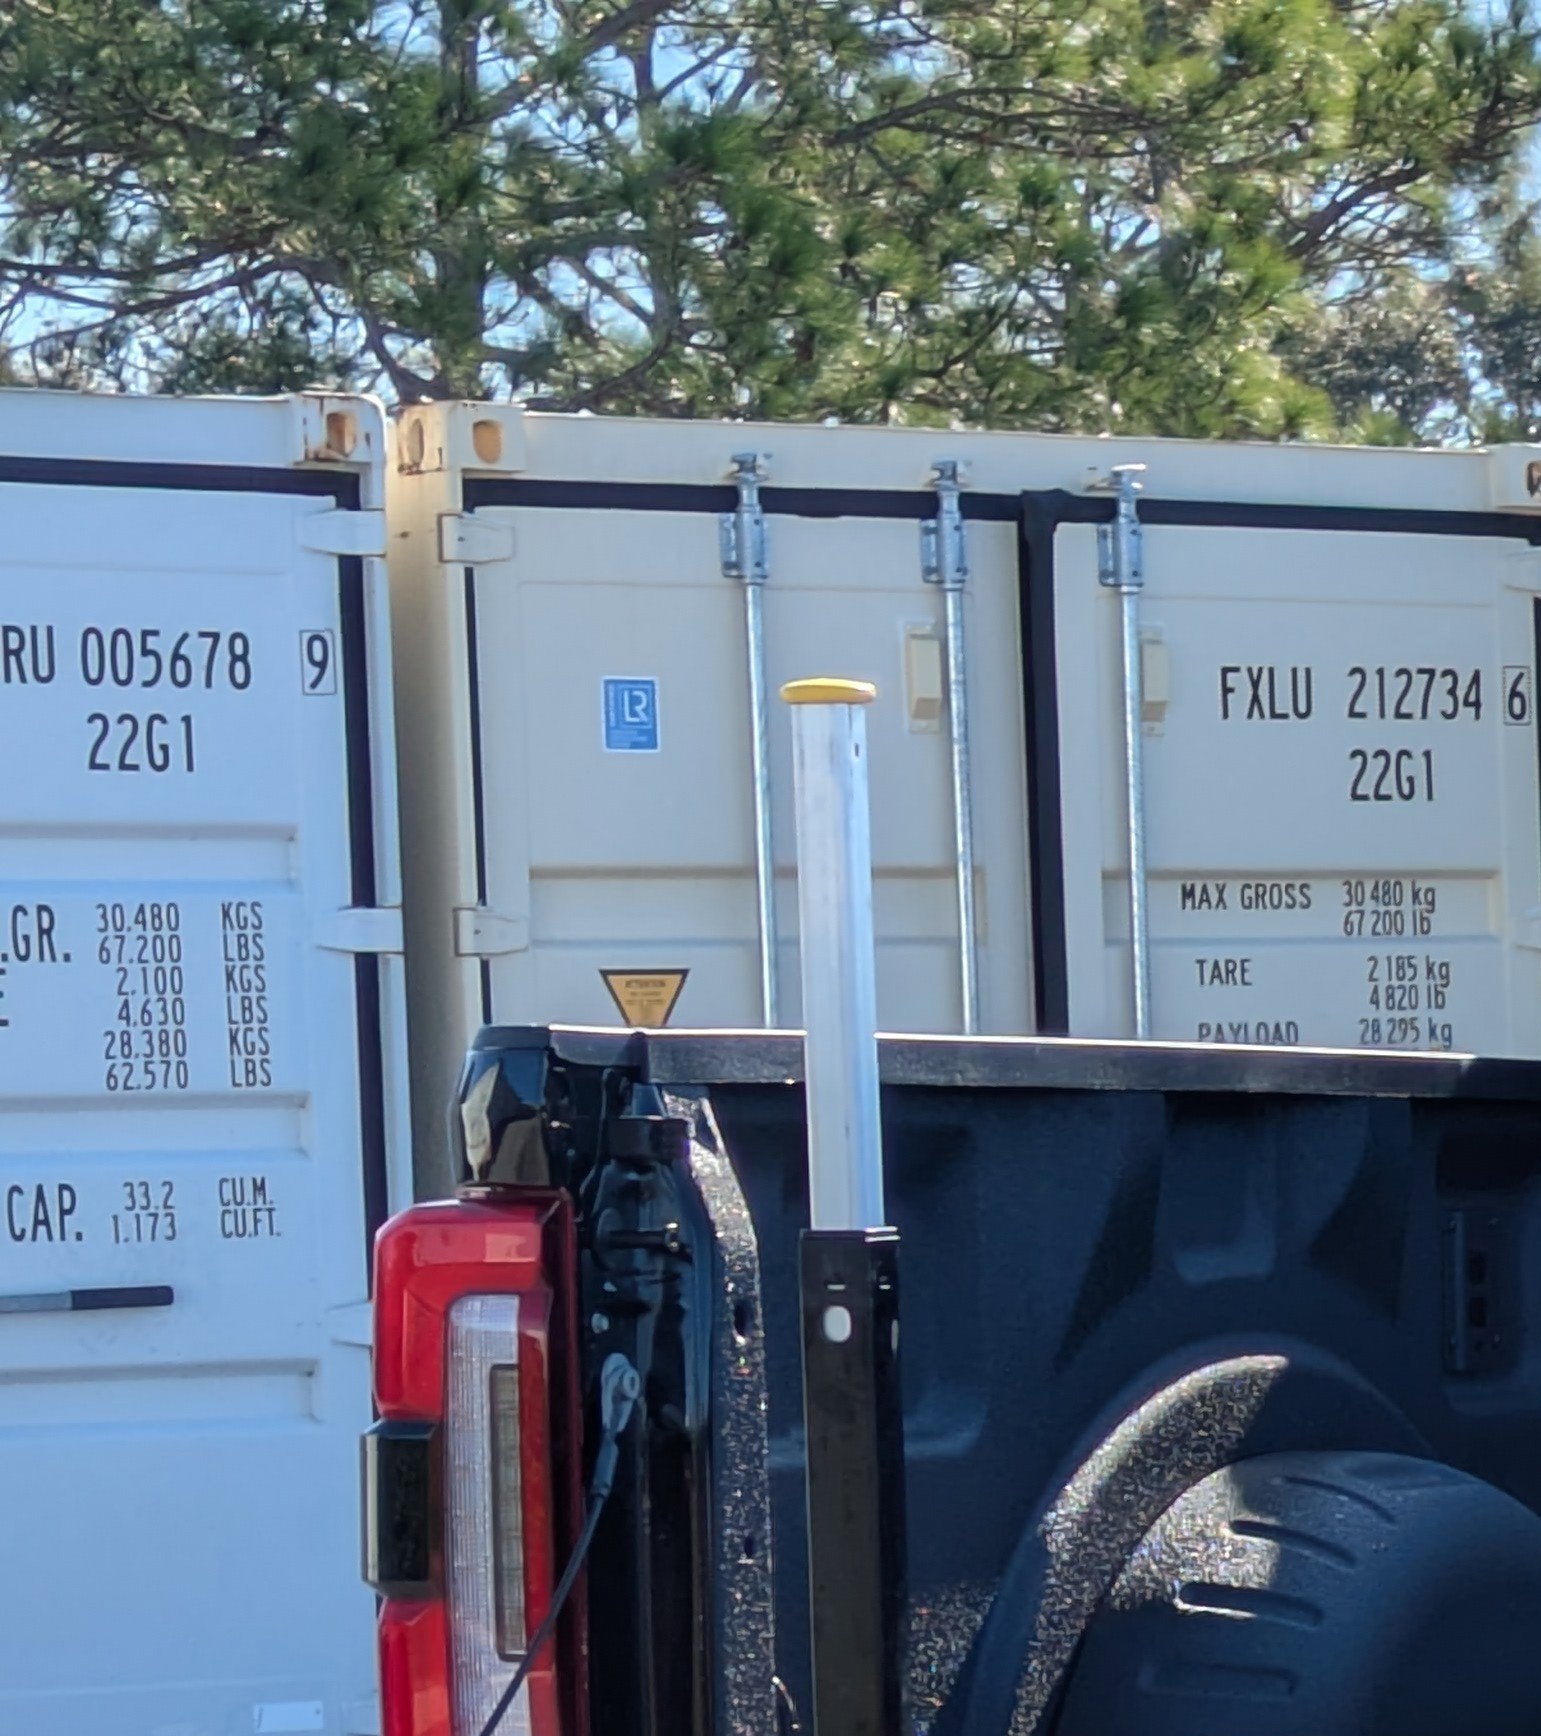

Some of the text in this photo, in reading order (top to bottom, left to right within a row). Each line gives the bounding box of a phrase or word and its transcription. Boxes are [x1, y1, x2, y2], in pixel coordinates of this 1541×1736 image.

[1, 624, 330, 691] RU 005678 9
[1219, 665, 1528, 721] FXLU 212734 6
[86, 712, 195, 773] 22G1
[1349, 748, 1434, 802] 22G1
[1180, 882, 1228, 910] MAX
[1240, 882, 1312, 910] GROSS
[1411, 879, 1437, 914] kg
[96, 902, 181, 933] 30.480
[221, 900, 264, 932] KGS
[1411, 908, 1432, 936] lb
[97, 932, 265, 965] 67.200 LBS
[116, 963, 267, 996] 2.100 KGS
[1195, 958, 1253, 987] TARE
[1424, 954, 1451, 987] kg
[117, 995, 269, 1028] 4.630 LBS
[1427, 983, 1446, 1011] lb
[103, 1026, 271, 1060] 28.380 KGS
[1197, 1020, 1300, 1047] PAYLOAD
[1427, 1017, 1453, 1050] kg
[105, 1057, 273, 1092] 62.570 LBS
[6, 1182, 84, 1243] CAP.
[122, 1180, 176, 1212] 33.2
[111, 1211, 178, 1244] 1.173
